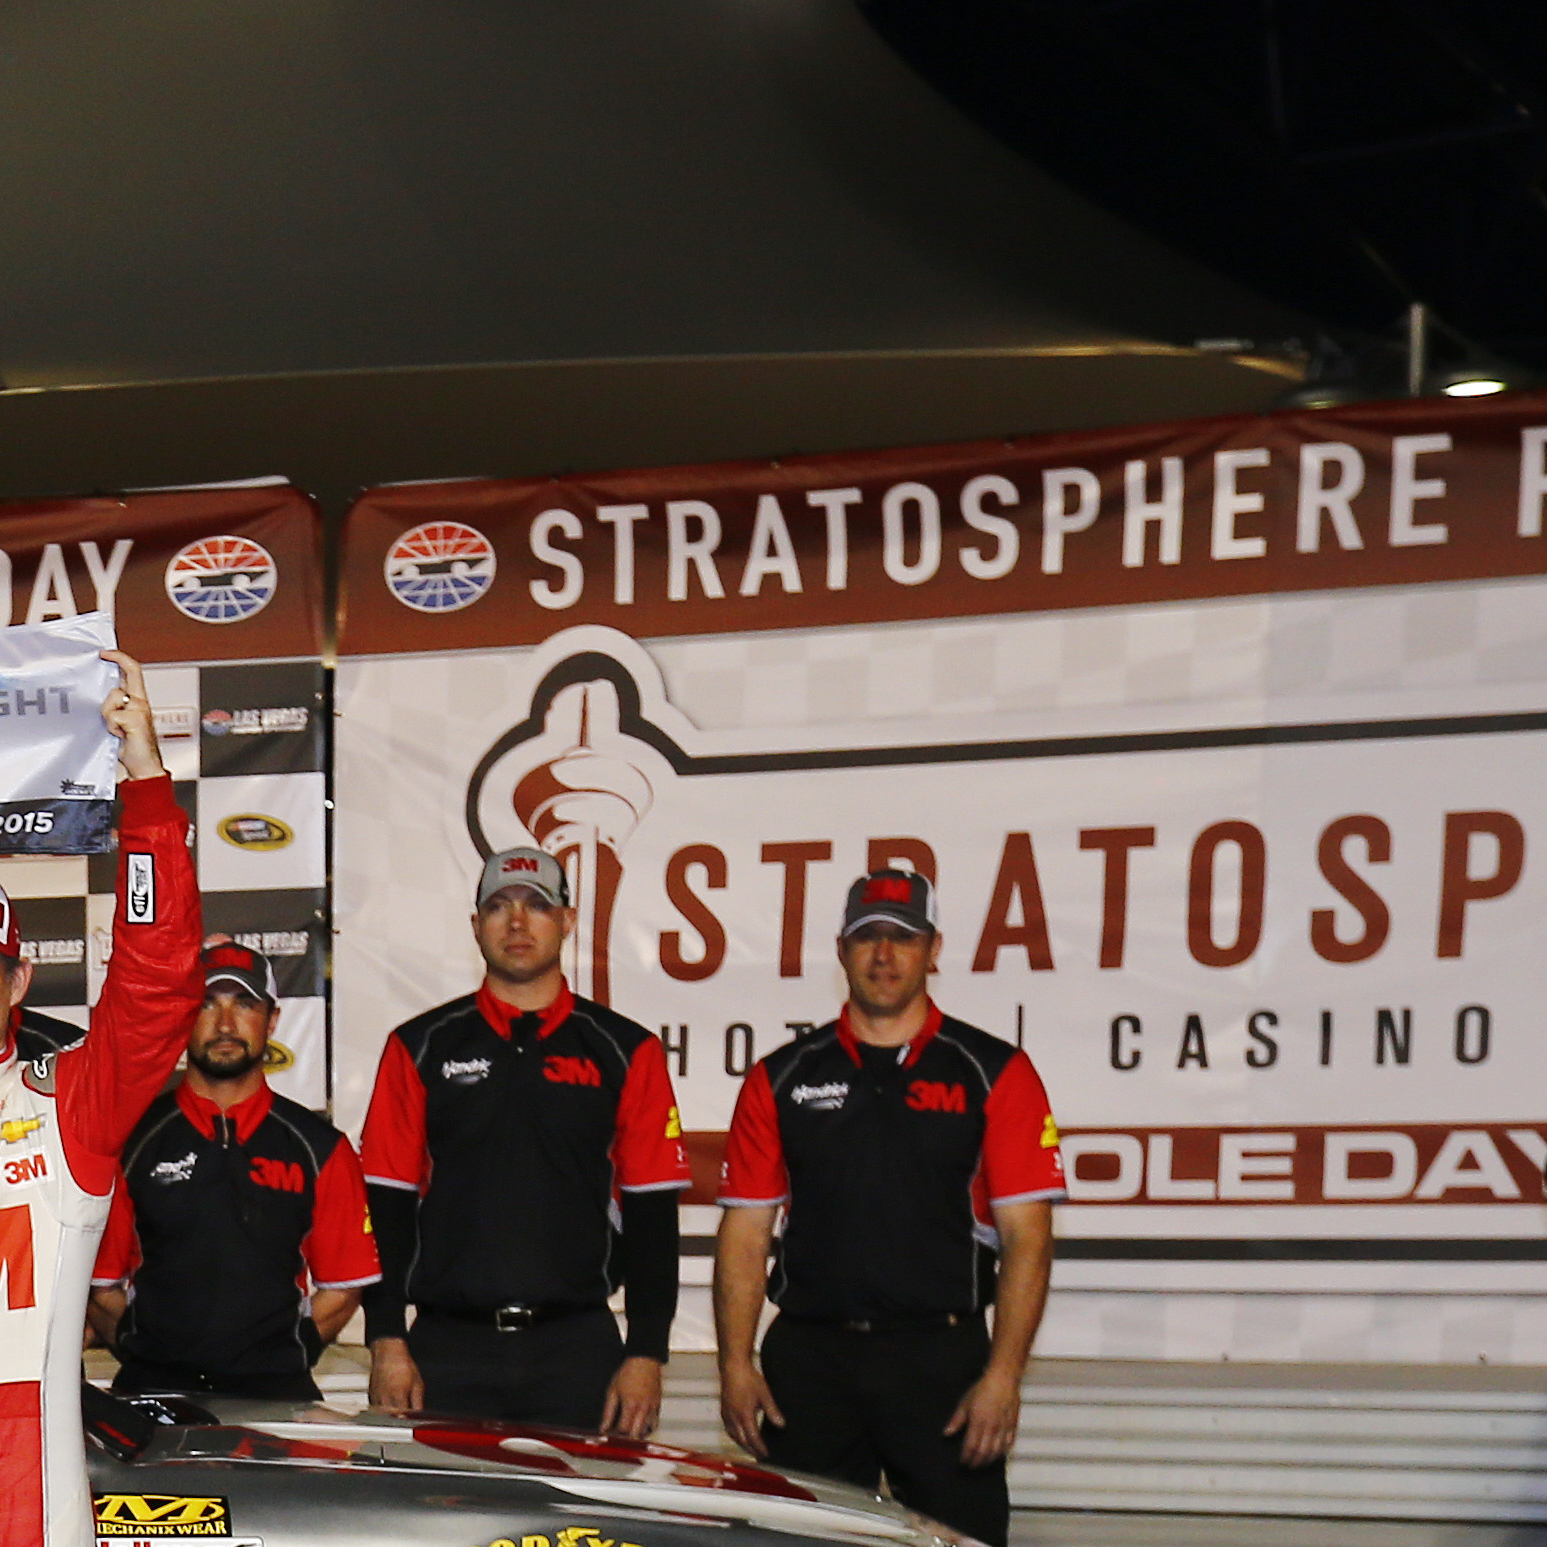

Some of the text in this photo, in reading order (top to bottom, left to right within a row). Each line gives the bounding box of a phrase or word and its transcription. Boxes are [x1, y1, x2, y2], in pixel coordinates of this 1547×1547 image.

[529, 433, 1451, 610] STRATOSPHERE
[501, 857, 539, 873] 3M
[1110, 1005, 1491, 1070] CASINO
[543, 1055, 601, 1087] 3M
[906, 1080, 966, 1113] 3M
[4, 1154, 47, 1184] 3M
[250, 1156, 304, 1193] 3M
[1060, 1133, 1297, 1200] OLE
[176, 1520, 227, 1535] WEAR
